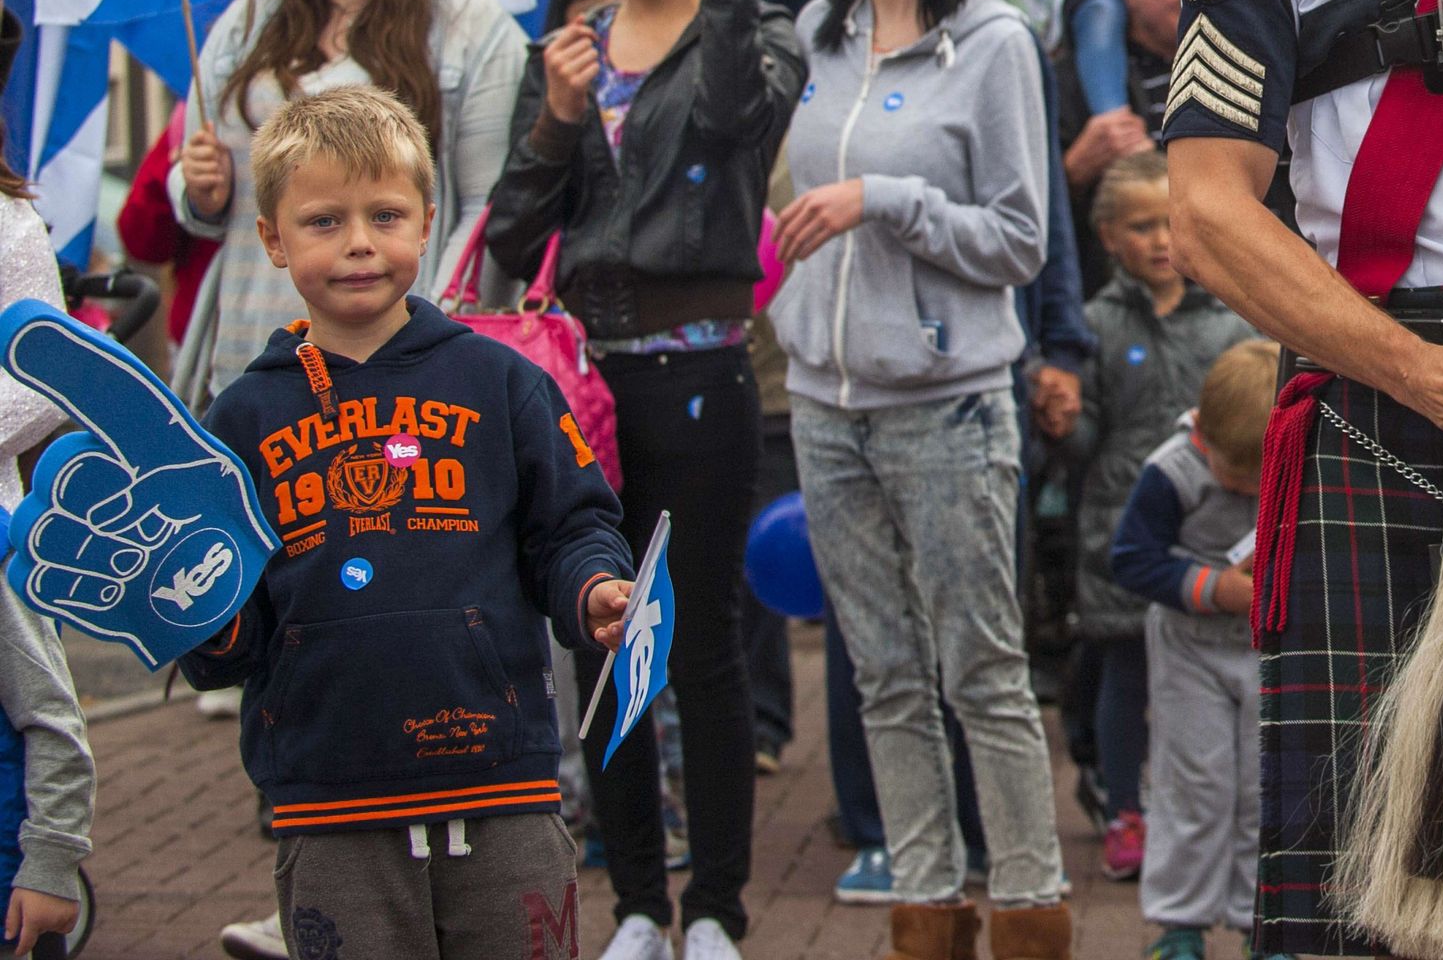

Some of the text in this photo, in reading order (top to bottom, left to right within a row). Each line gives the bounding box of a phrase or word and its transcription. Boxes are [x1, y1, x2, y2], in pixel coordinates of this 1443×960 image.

[259, 396, 481, 480] EVERLAST
[386, 443, 418, 459] Yes
[349, 512, 391, 537] EVERLAST
[407, 517, 480, 532] CHAMPION
[286, 531, 326, 558] BOXING
[151, 542, 233, 611] Yes
[346, 566, 367, 583] Yes
